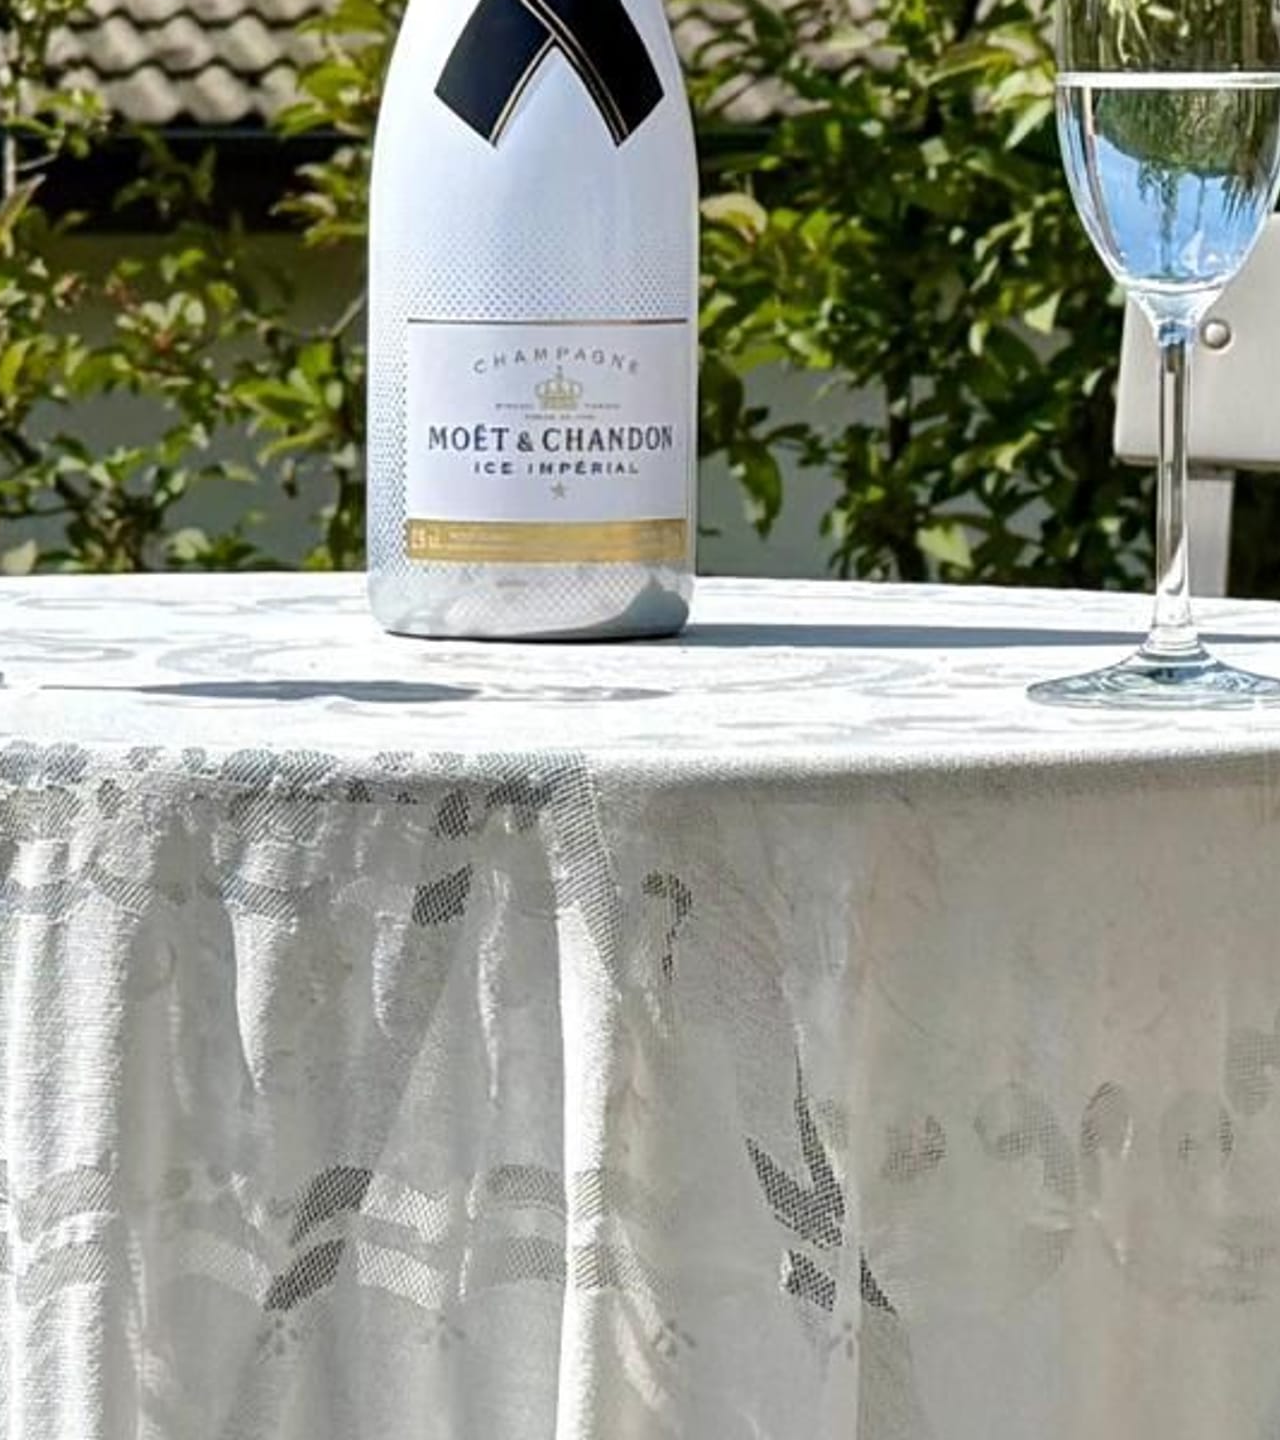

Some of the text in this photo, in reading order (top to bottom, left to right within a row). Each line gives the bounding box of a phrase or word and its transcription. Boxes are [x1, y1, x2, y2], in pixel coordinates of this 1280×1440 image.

[473, 346, 638, 374] CHAMPAGNE
[517, 430, 535, 452] &
[541, 425, 673, 452] CHANDON
[474, 459, 639, 475] ICE IMPÉRIAL
